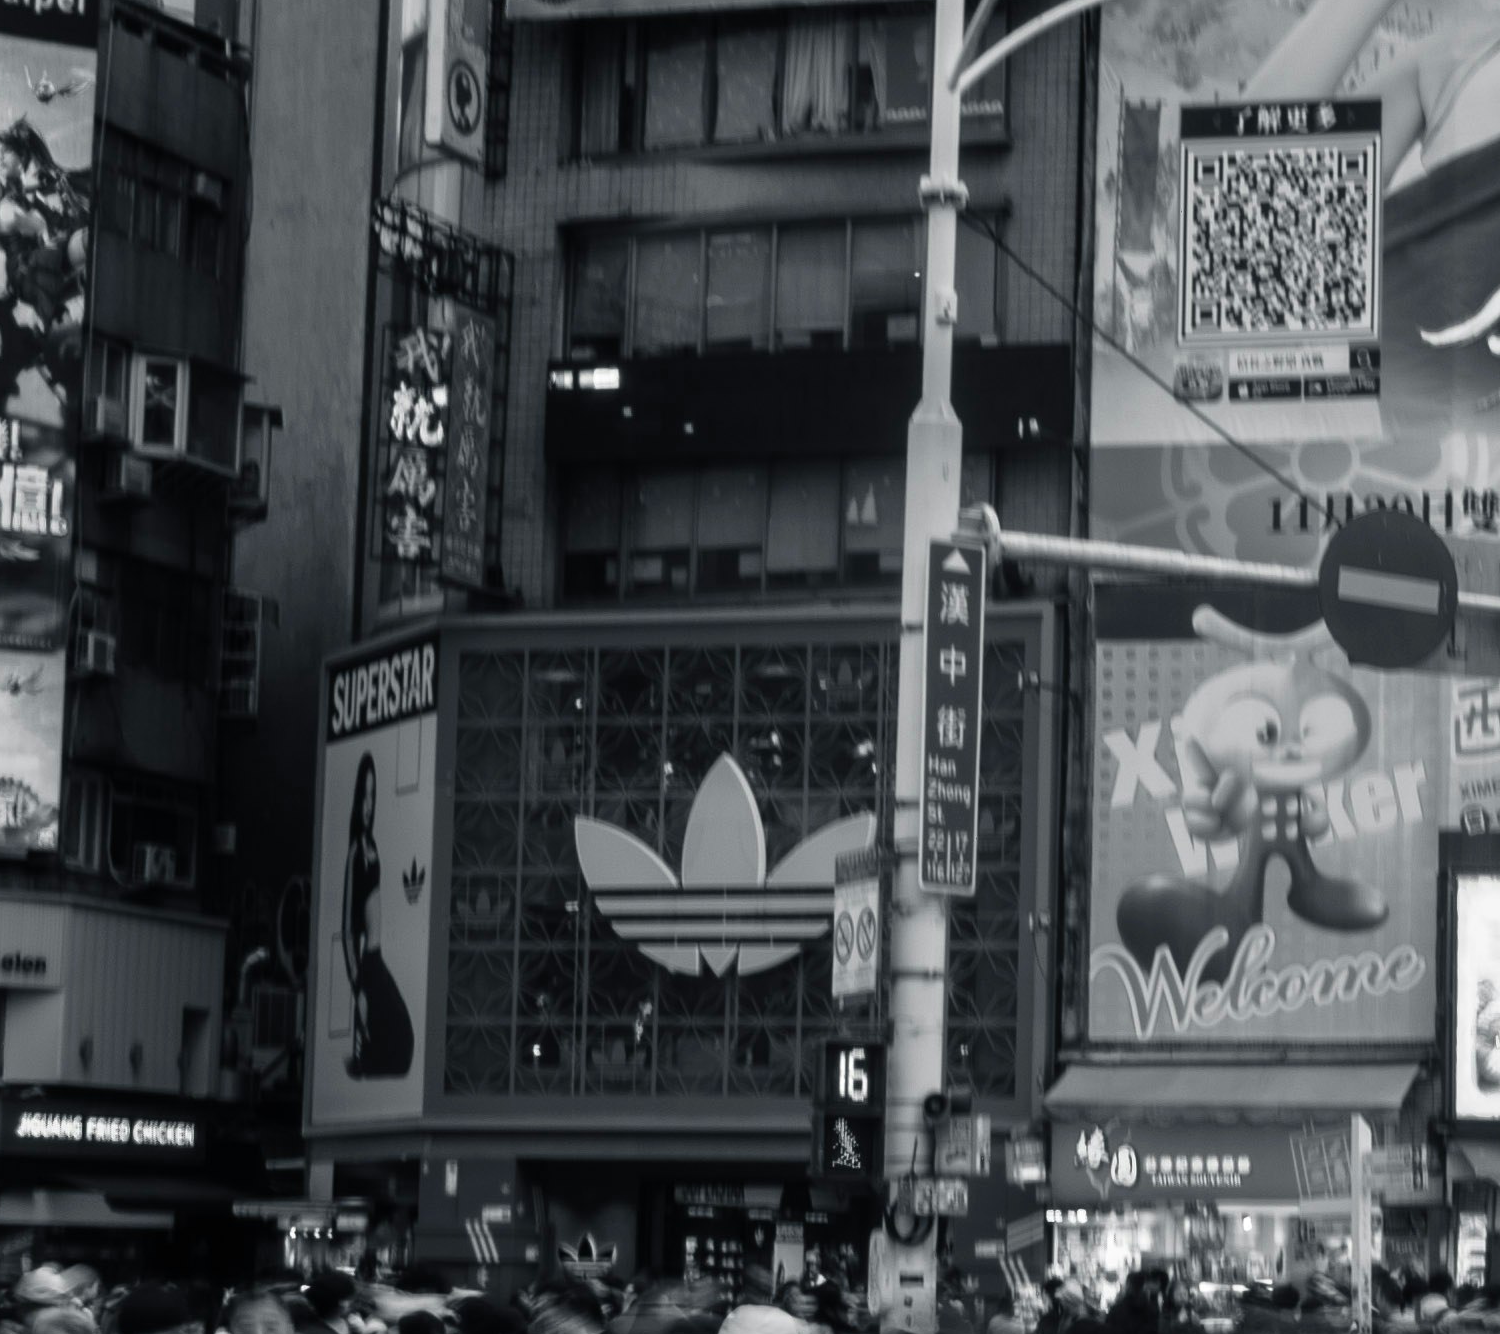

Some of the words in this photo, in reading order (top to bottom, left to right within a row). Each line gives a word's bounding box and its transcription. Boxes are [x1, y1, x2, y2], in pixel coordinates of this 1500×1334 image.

[331, 643, 436, 736] SUPERSTAR
[937, 580, 971, 752] 漢中街
[927, 752, 957, 779] Han
[927, 776, 971, 810] Zhong
[1089, 923, 1428, 1042] Welcome
[836, 1047, 869, 1104] 16
[16, 1111, 84, 1141] JIGUANG
[85, 1114, 132, 1144] FRIED
[132, 1118, 196, 1149] CHICKEN
